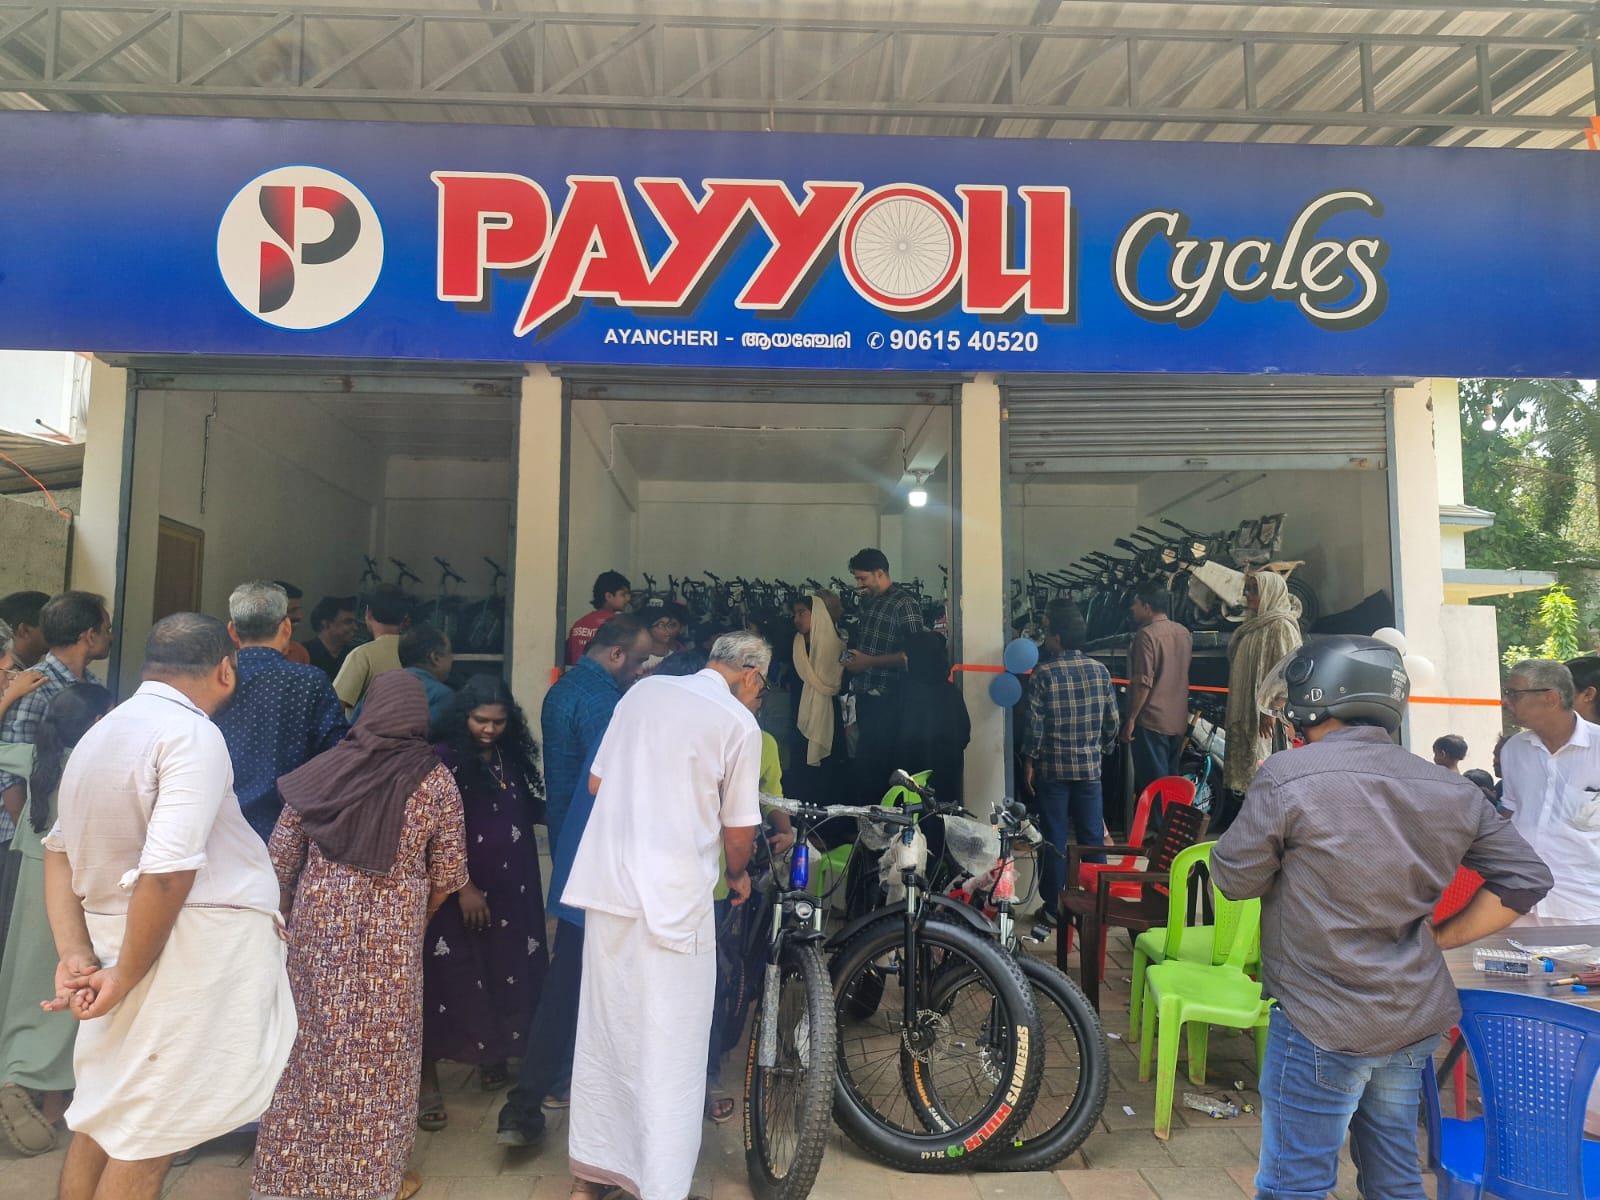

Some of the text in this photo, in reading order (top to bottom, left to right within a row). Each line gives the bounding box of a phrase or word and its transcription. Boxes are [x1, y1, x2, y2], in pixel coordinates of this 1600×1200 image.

[430, 171, 1380, 338] PAYYOU Cycles
[603, 329, 719, 347] AYANCHERI
[741, 330, 852, 351] ആയഞ്ചേരി
[889, 329, 961, 351] 90615
[967, 331, 1039, 353] 40520
[1005, 1025, 1029, 1106] SPEEDWAYS
[963, 1102, 1013, 1152] HULK
